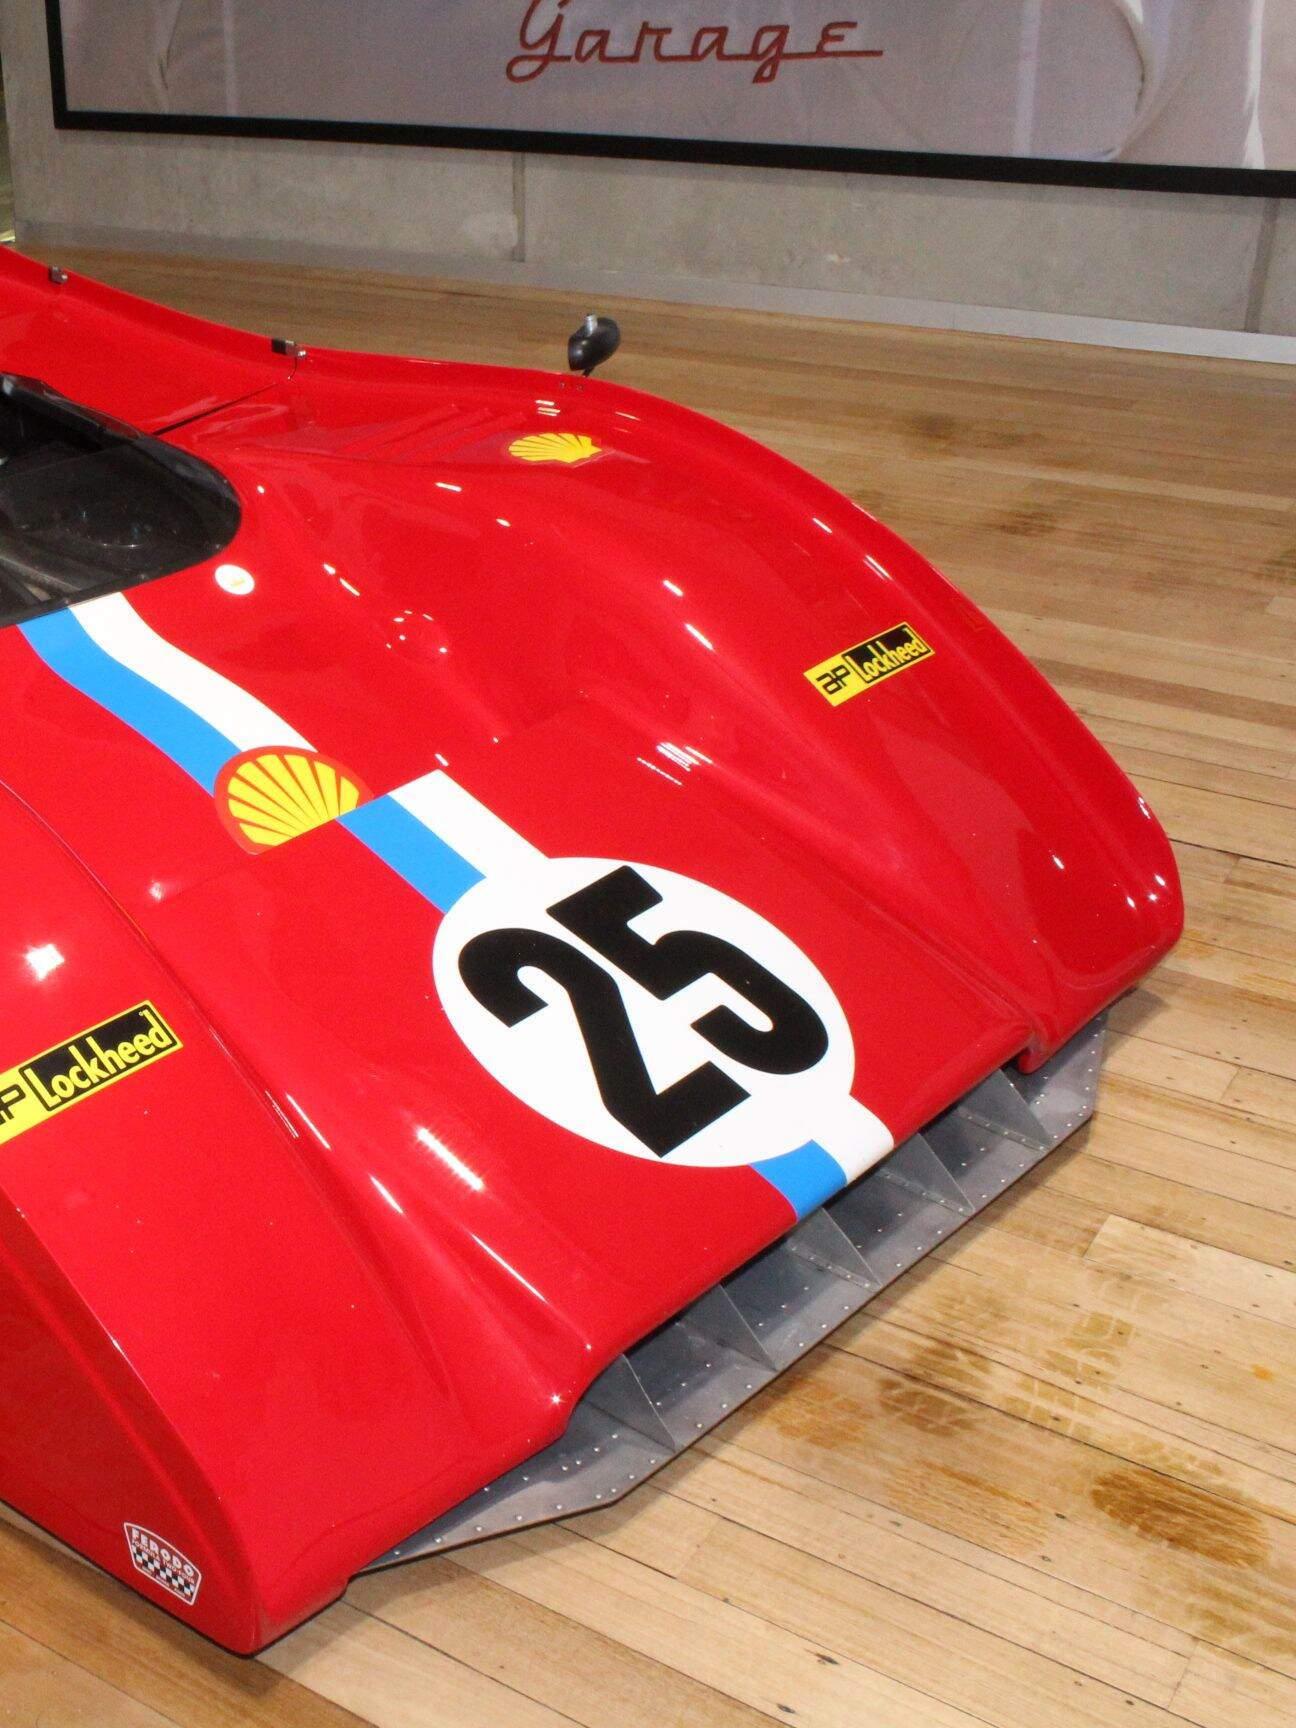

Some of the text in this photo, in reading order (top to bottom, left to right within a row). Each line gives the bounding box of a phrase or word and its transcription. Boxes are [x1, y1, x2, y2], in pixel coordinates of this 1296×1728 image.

[504, 0, 884, 84] Garage
[844, 626, 928, 682] Lockheed
[457, 864, 829, 1158] 25
[23, 1008, 173, 1109] Lockheed
[131, 1527, 195, 1577] FERODO
